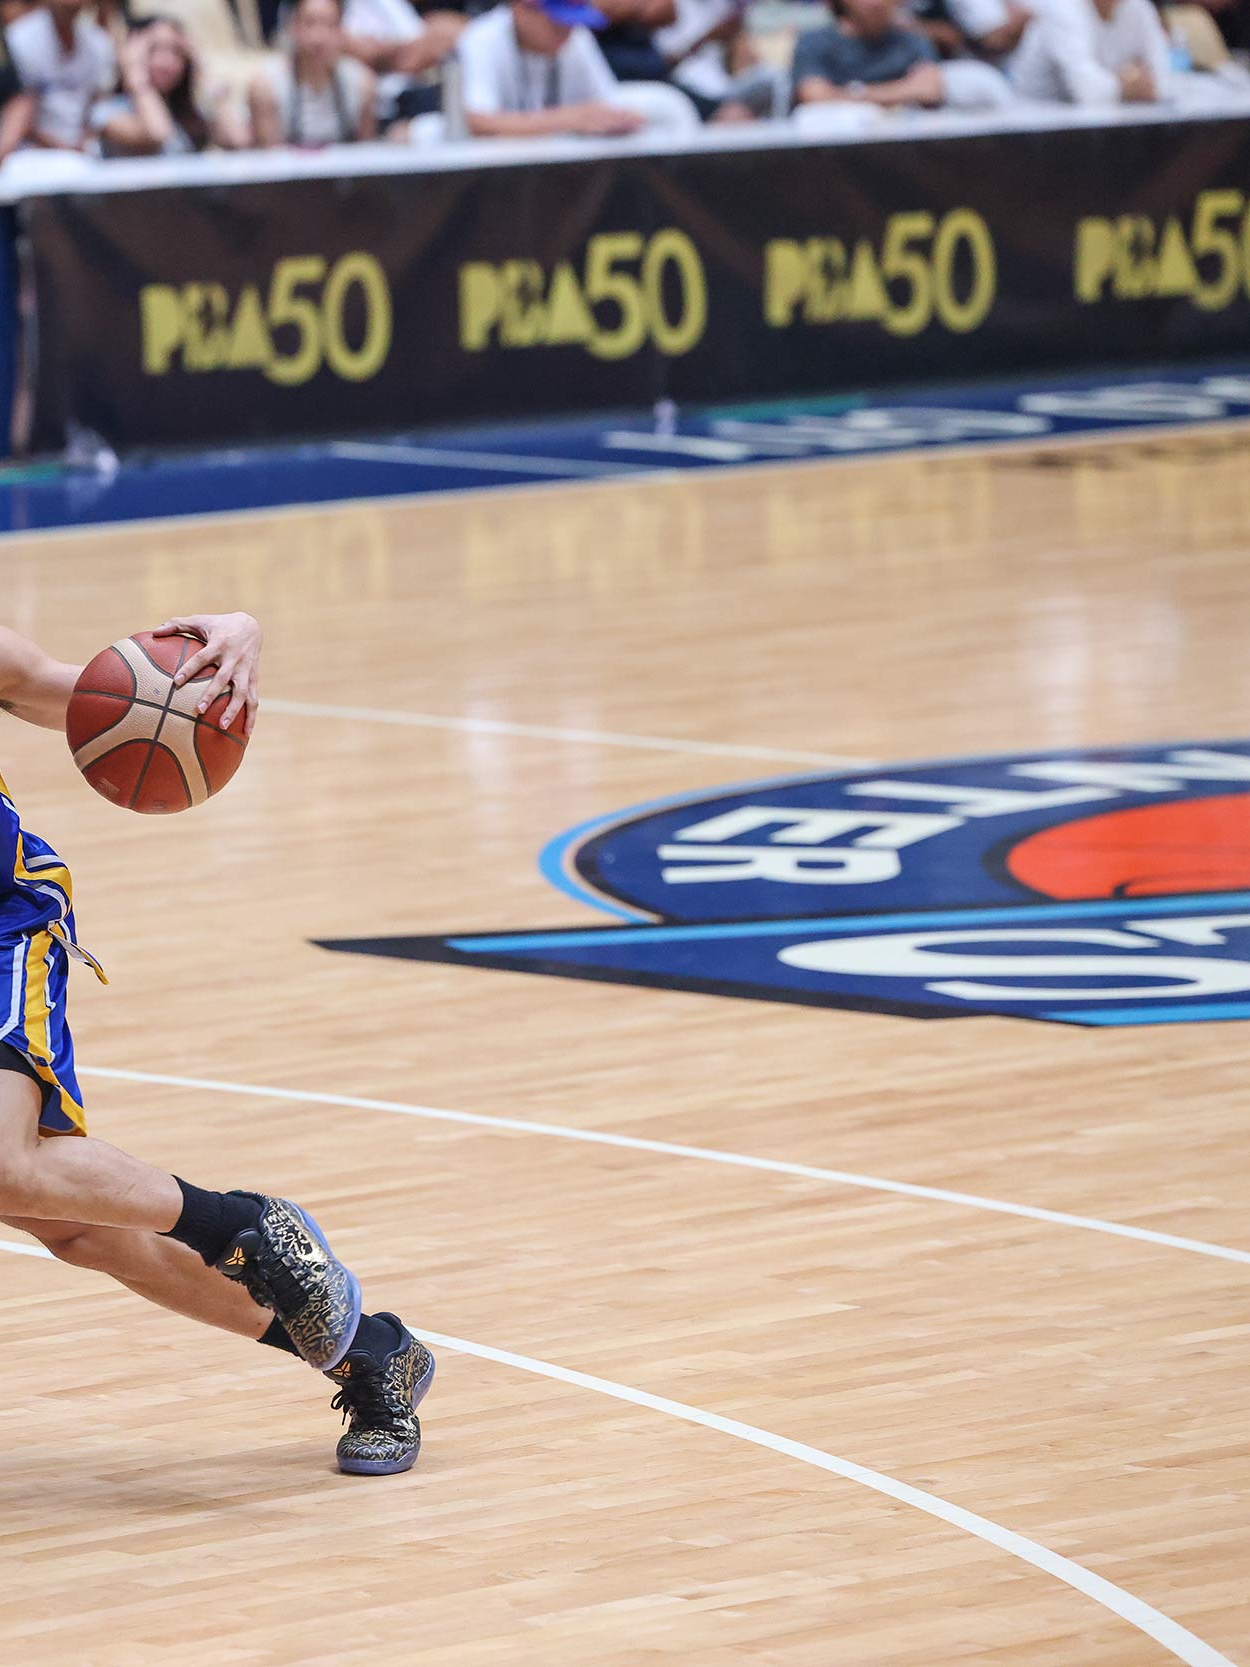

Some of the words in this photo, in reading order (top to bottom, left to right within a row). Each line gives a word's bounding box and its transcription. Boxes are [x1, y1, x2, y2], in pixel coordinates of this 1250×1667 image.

[459, 228, 709, 360] PBA50
[763, 207, 997, 337] PBA50
[1073, 188, 1250, 311] PBA5
[139, 249, 393, 386] PBA50
